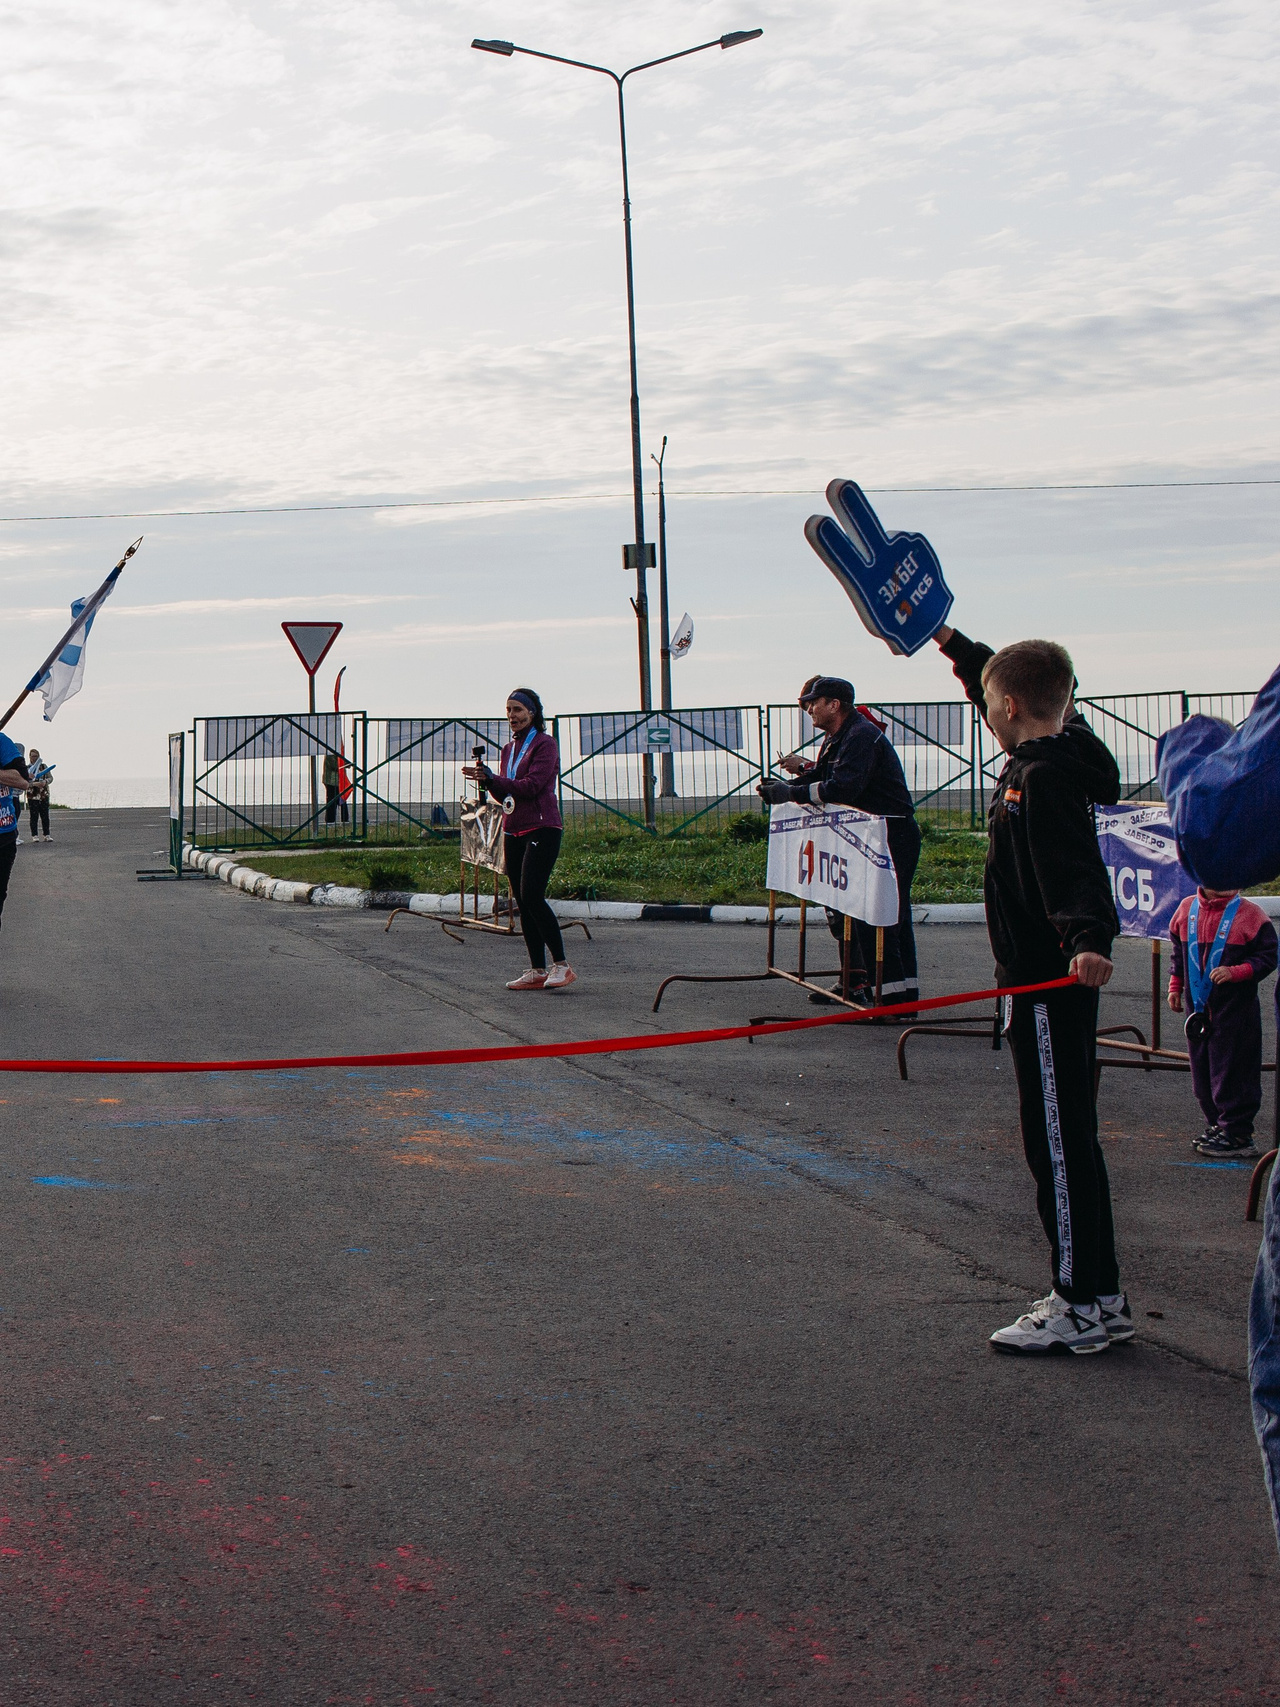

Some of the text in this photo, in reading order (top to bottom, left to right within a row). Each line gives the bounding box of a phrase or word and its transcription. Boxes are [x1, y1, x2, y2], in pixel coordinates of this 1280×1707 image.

[910, 573, 933, 606] ПСБ
[1124, 829, 1165, 849] ЗАБЕГ.РФ
[819, 850, 848, 891] ПСБ
[1040, 1018, 1048, 1035] OPEN
[1044, 1037, 1052, 1069] YOURSELF
